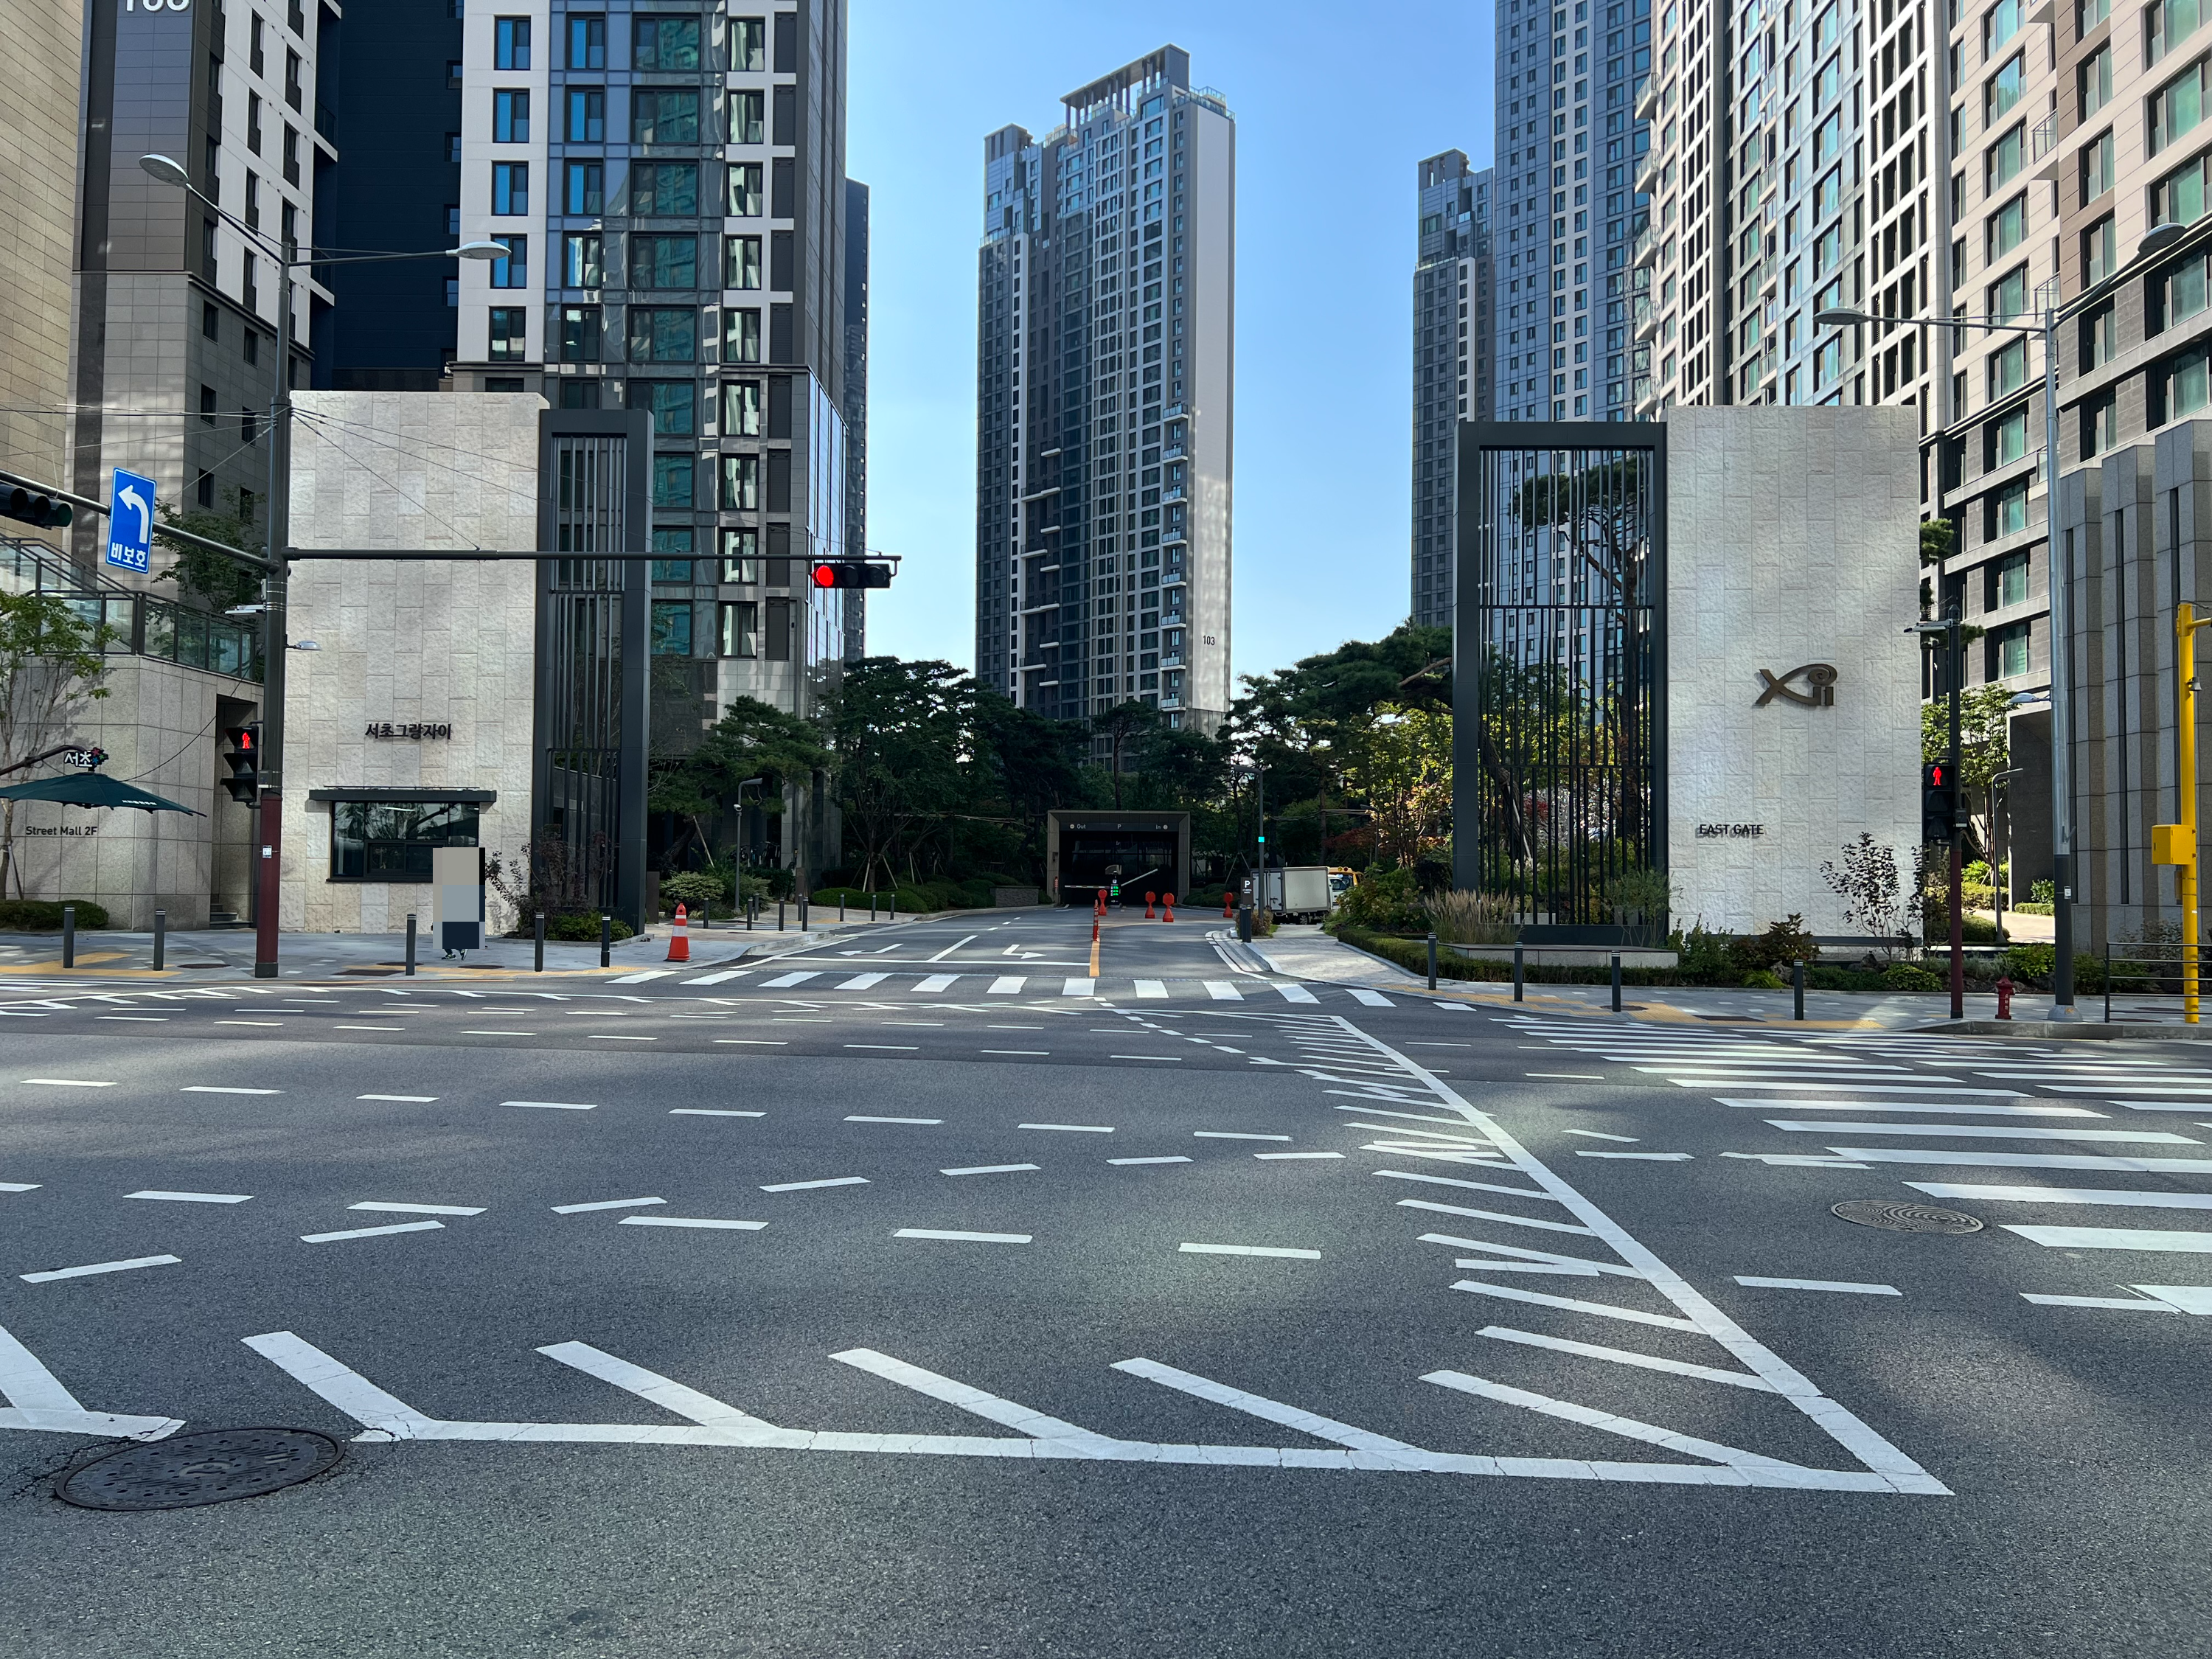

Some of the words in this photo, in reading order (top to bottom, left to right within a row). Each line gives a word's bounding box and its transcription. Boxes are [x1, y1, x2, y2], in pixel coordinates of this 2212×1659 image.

[111, 542, 146, 568] 비보호
[1203, 635, 1215, 646] 103
[365, 723, 452, 740] 서초그랑자이
[64, 751, 93, 768] 서초
[26, 826, 57, 835] Street
[60, 826, 82, 835] Mall
[84, 826, 97, 835] 2F
[1700, 824, 1731, 835] EAST
[1733, 824, 1764, 835] GATE
[1244, 880, 1251, 888] P
